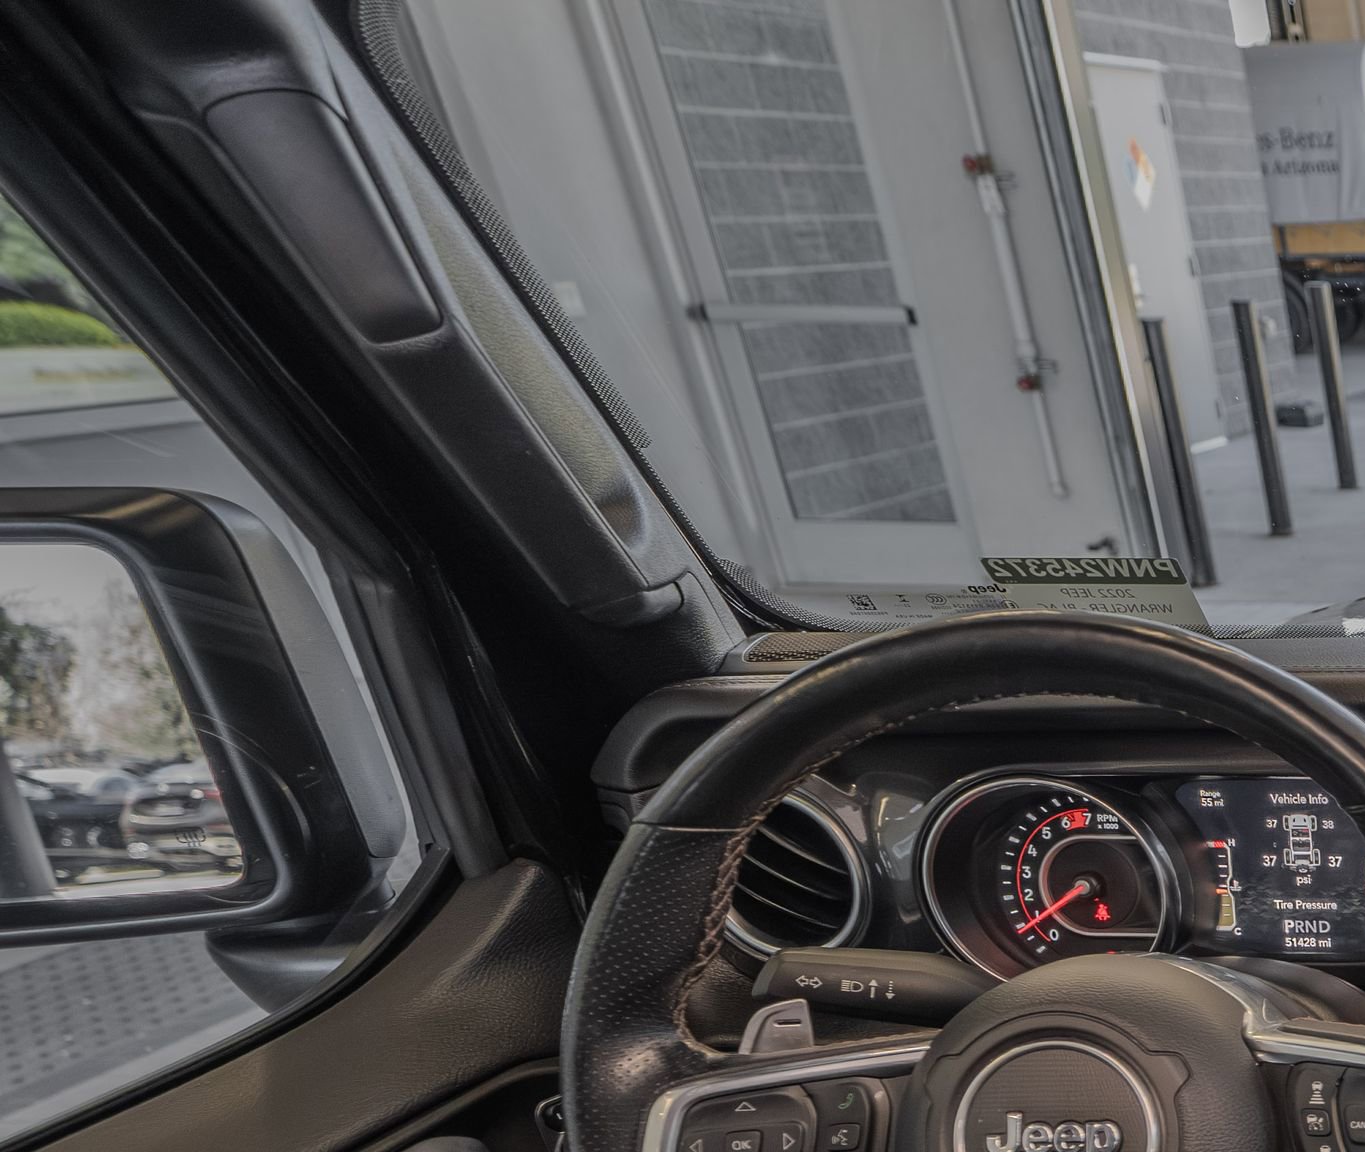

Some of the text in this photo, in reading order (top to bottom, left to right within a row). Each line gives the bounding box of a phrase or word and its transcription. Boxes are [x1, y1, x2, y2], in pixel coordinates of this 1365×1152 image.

[1200, 790, 1221, 798] Range
[1270, 793, 1329, 805] Vehicle Info
[1201, 798, 1213, 807] 55
[1061, 816, 1071, 829] 6
[1083, 813, 1092, 825] 7
[1266, 820, 1278, 829] 37
[1042, 826, 1052, 839] 5
[1027, 844, 1038, 857] 4
[1262, 855, 1277, 866] 37
[1328, 856, 1342, 867] 37
[1022, 866, 1032, 879] 3
[1296, 875, 1312, 886] psi
[1024, 888, 1034, 901] 2
[1274, 899, 1338, 910] Tire Pressure
[1050, 929, 1059, 941] 0
[1285, 938, 1332, 947] 51428 mi
[731, 1139, 752, 1151] OK
